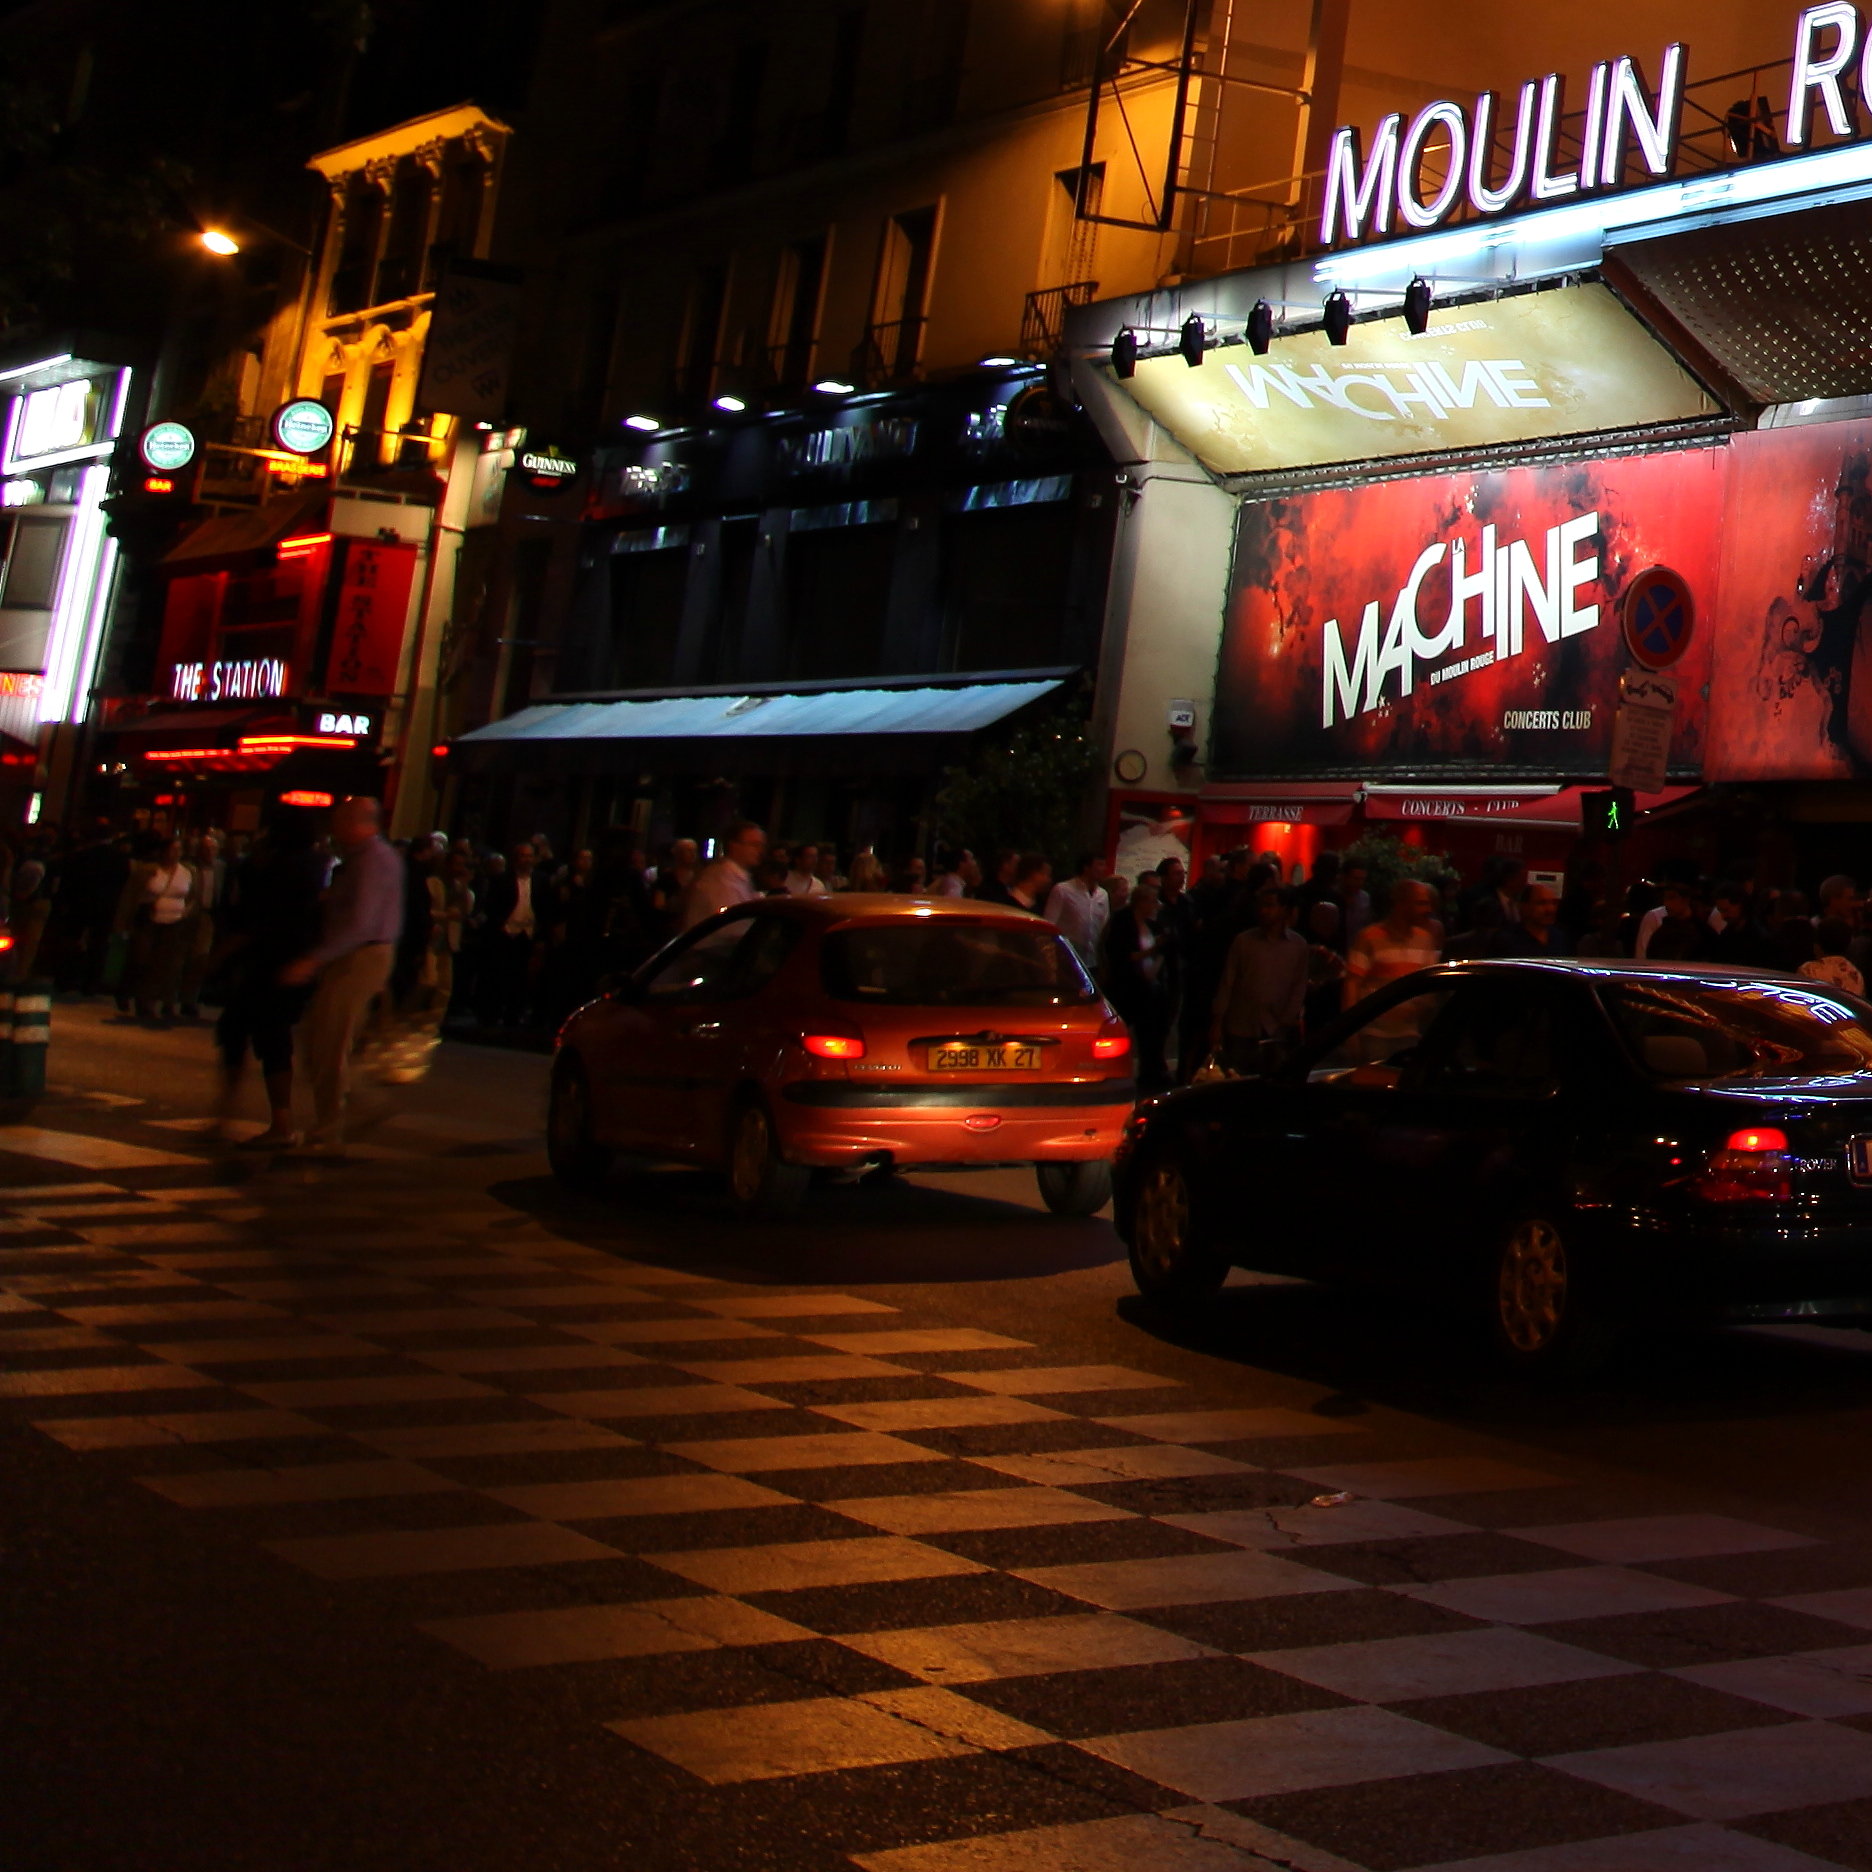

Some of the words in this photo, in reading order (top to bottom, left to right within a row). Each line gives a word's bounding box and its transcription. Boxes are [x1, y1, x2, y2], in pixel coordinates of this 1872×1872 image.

[1319, 42, 1690, 246] MOULIN
[1323, 511, 1600, 729] MACHINE
[173, 662, 204, 701] THE
[211, 657, 284, 701] STATION
[319, 712, 372, 735] BAR
[1503, 710, 1560, 730] CONCERTS
[1562, 710, 1591, 730] CLUB
[1248, 804, 1304, 822] TERRASSE
[1401, 799, 1466, 817] CONCERTS
[1015, 1048, 1034, 1067] 27
